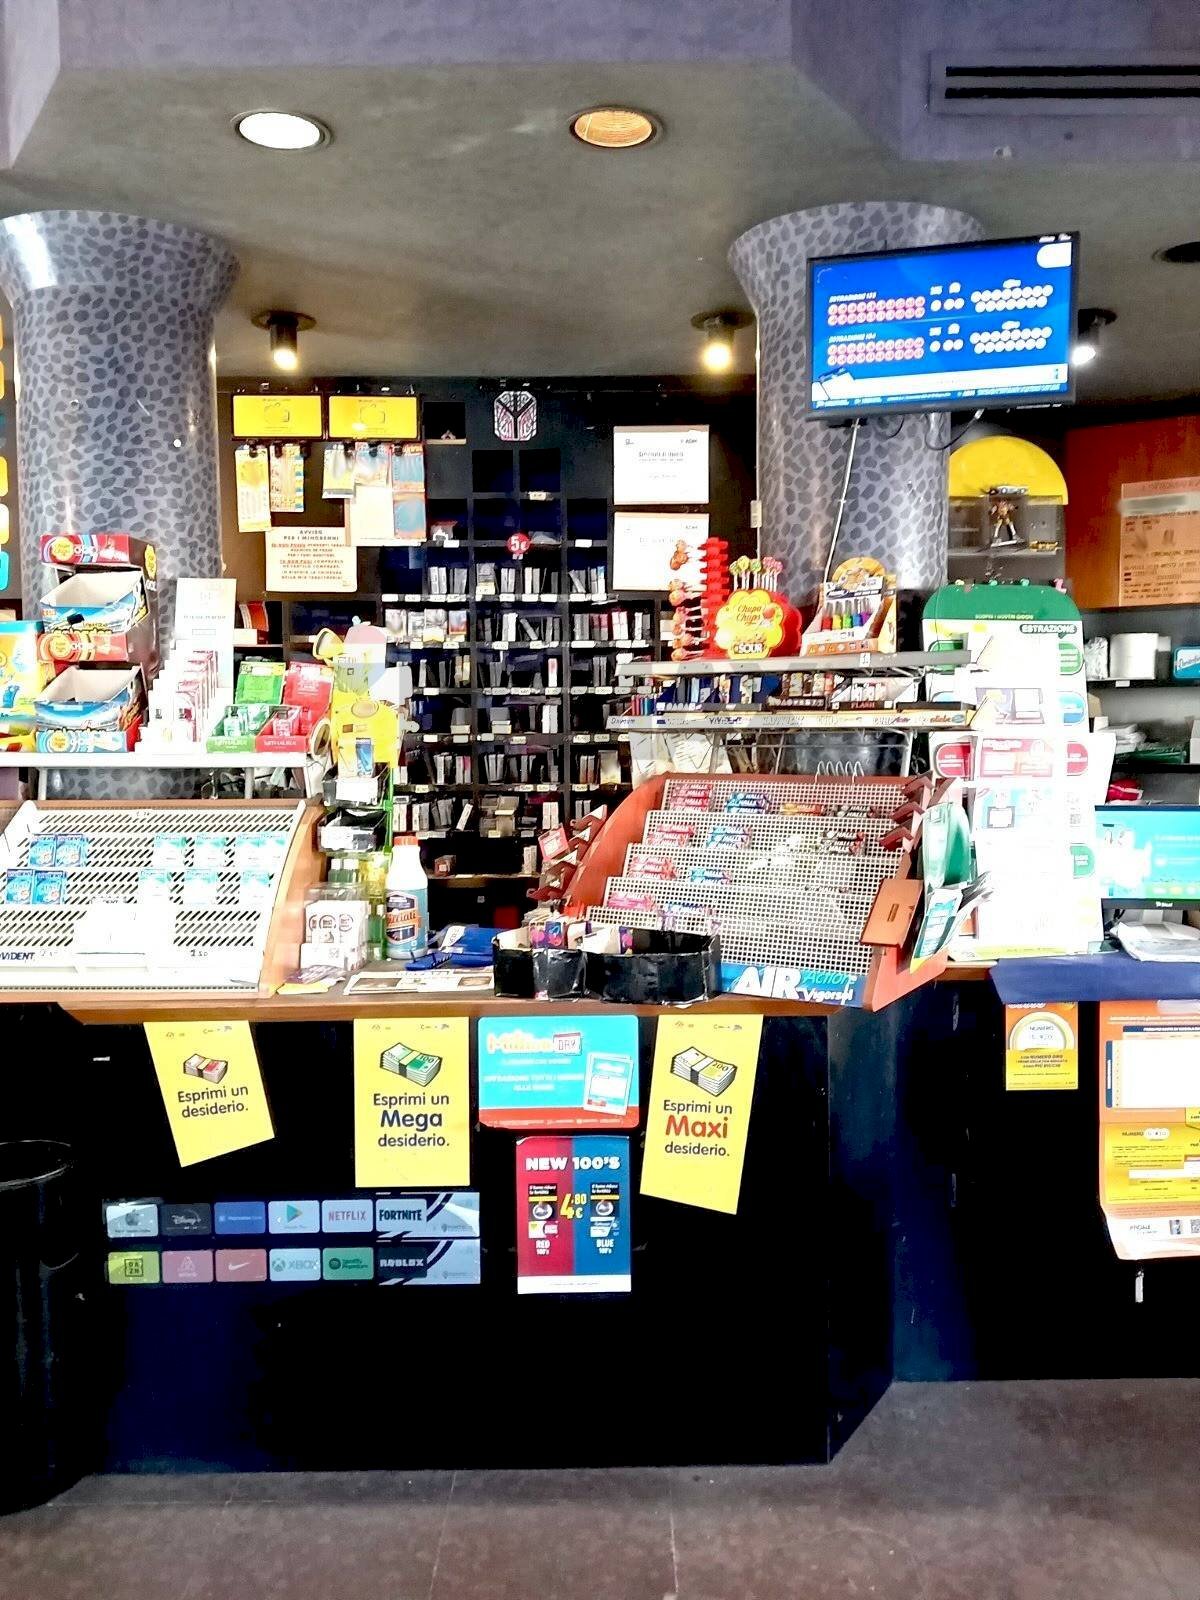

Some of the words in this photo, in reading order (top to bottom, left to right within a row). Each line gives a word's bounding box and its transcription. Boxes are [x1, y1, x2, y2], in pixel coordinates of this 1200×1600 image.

[0, 951, 35, 960] VIDENT
[731, 966, 802, 999] AIR
[177, 1086, 227, 1104] Esprimi
[231, 1086, 249, 1097] un
[373, 1093, 426, 1109] Esprimi
[431, 1095, 450, 1105] un
[181, 1100, 249, 1118] desiderio.
[663, 1099, 712, 1115] Esprimi
[715, 1104, 733, 1115] un
[380, 1109, 443, 1132] Mega
[665, 1114, 729, 1139] Maxi
[377, 1133, 450, 1147] desiderio.
[664, 1141, 730, 1157] desiderio.
[525, 1157, 568, 1171] NEW
[328, 1210, 367, 1222] NETFLIX
[378, 1209, 422, 1221] FORTNITE
[379, 1258, 424, 1268] ROBLOX
